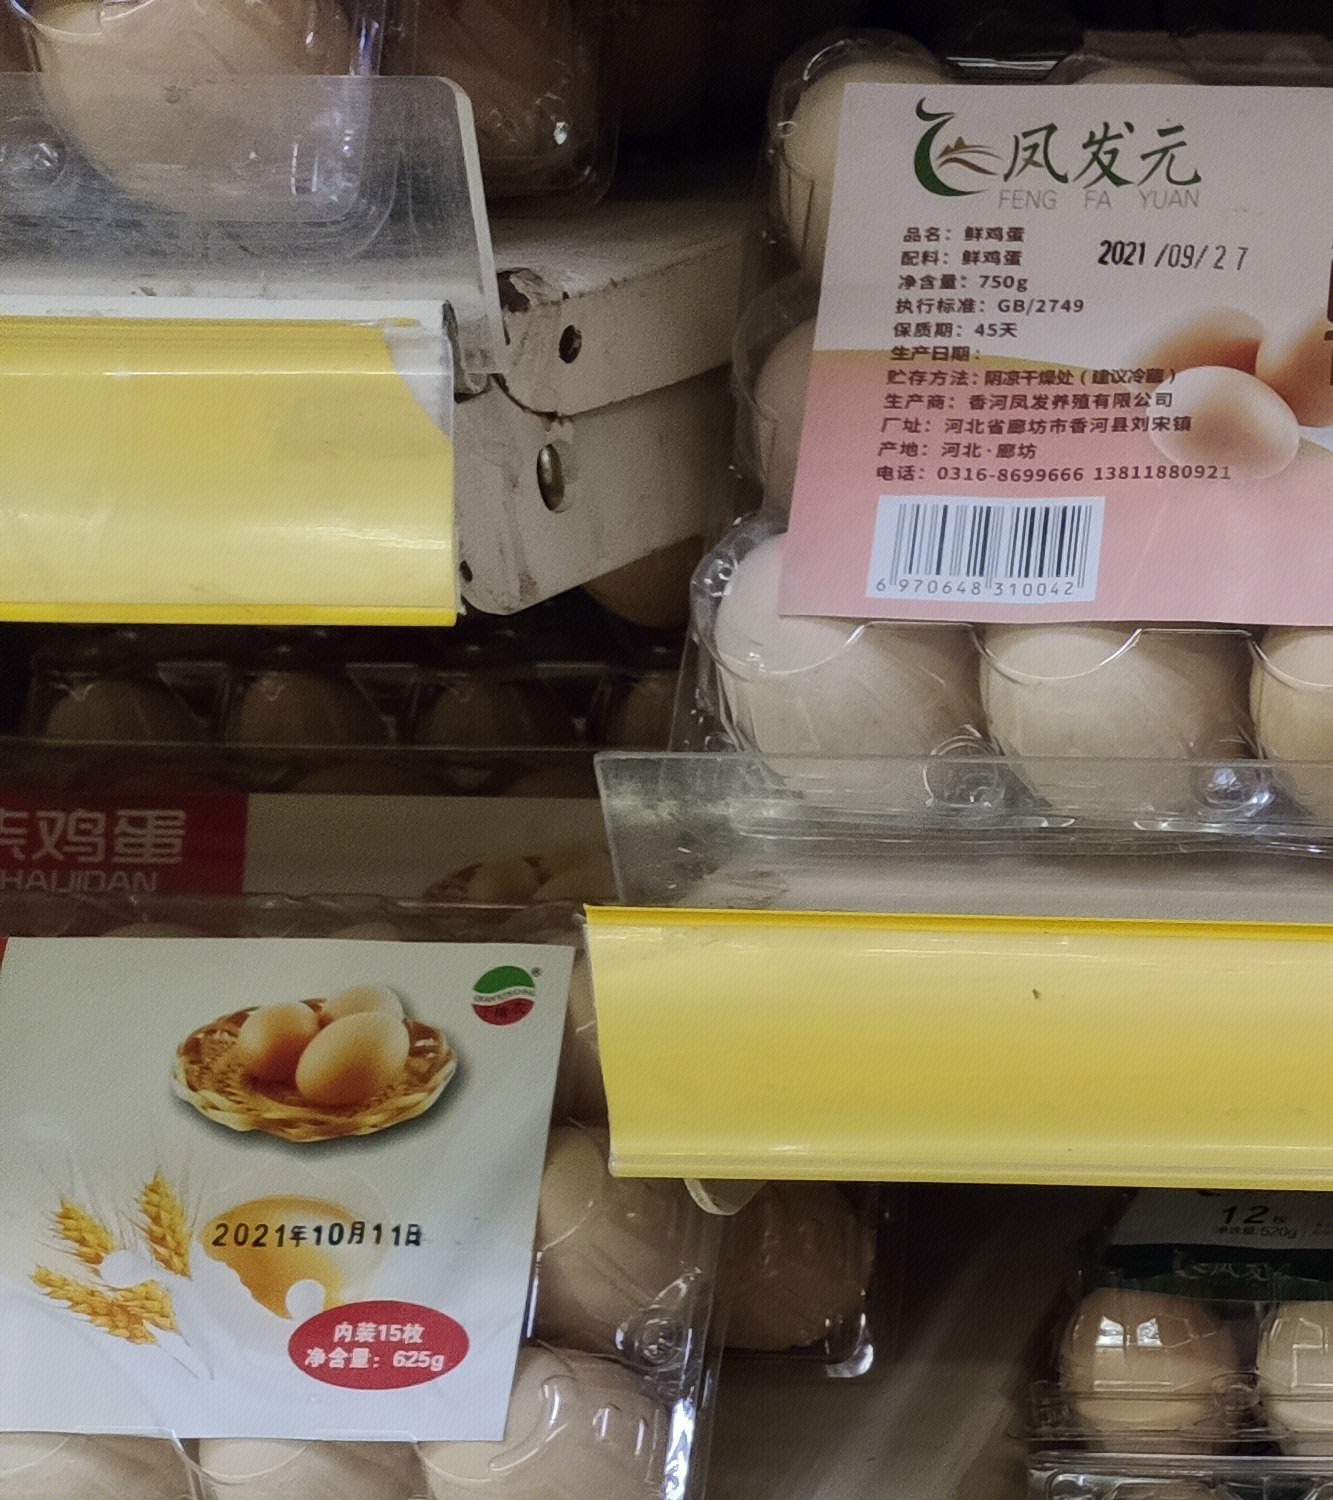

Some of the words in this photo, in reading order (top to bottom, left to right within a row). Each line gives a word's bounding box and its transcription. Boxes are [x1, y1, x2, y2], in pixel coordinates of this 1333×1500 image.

[1003, 120, 1202, 188] 凤发元
[999, 190, 1058, 210] FENG
[1084, 189, 1112, 209] FA
[1138, 189, 1200, 210] YUAN
[211, 1221, 424, 1248] 2021年10月11日
[333, 1321, 424, 1345] 内装15枚
